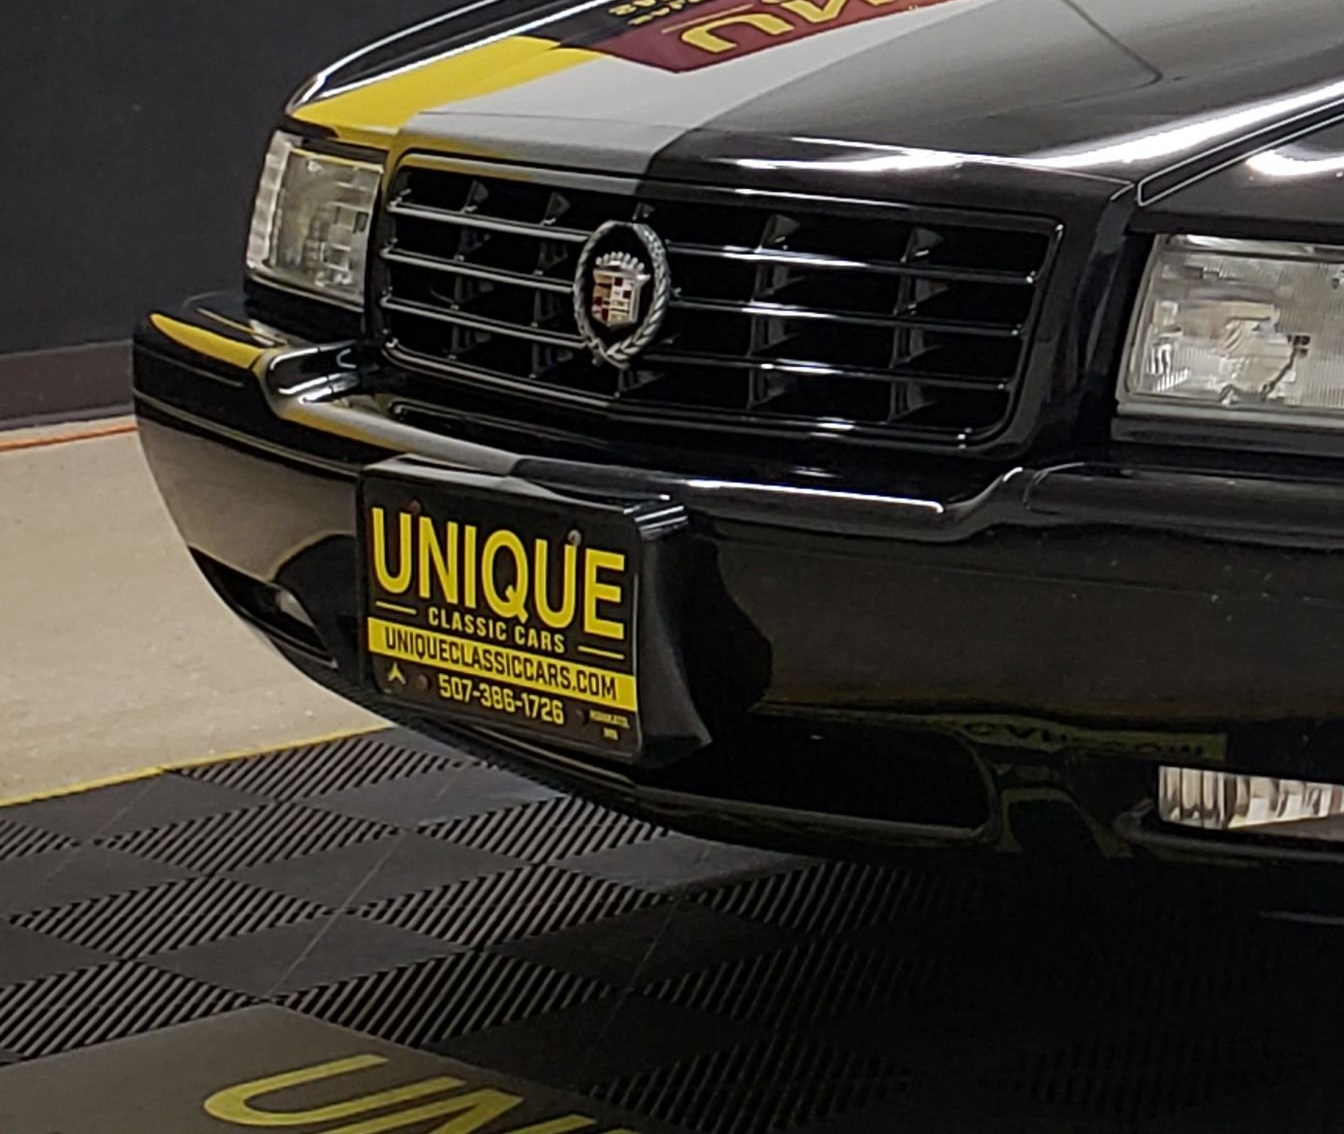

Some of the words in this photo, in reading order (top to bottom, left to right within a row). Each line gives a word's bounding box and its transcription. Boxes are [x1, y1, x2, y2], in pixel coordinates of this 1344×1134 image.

[372, 507, 625, 640] UNIQUE
[428, 606, 507, 642] CLASSIC
[514, 625, 565, 654] CARS
[384, 626, 617, 701] UNIQUECLASSICCARS.COM
[439, 673, 564, 725] 507-386-1726
